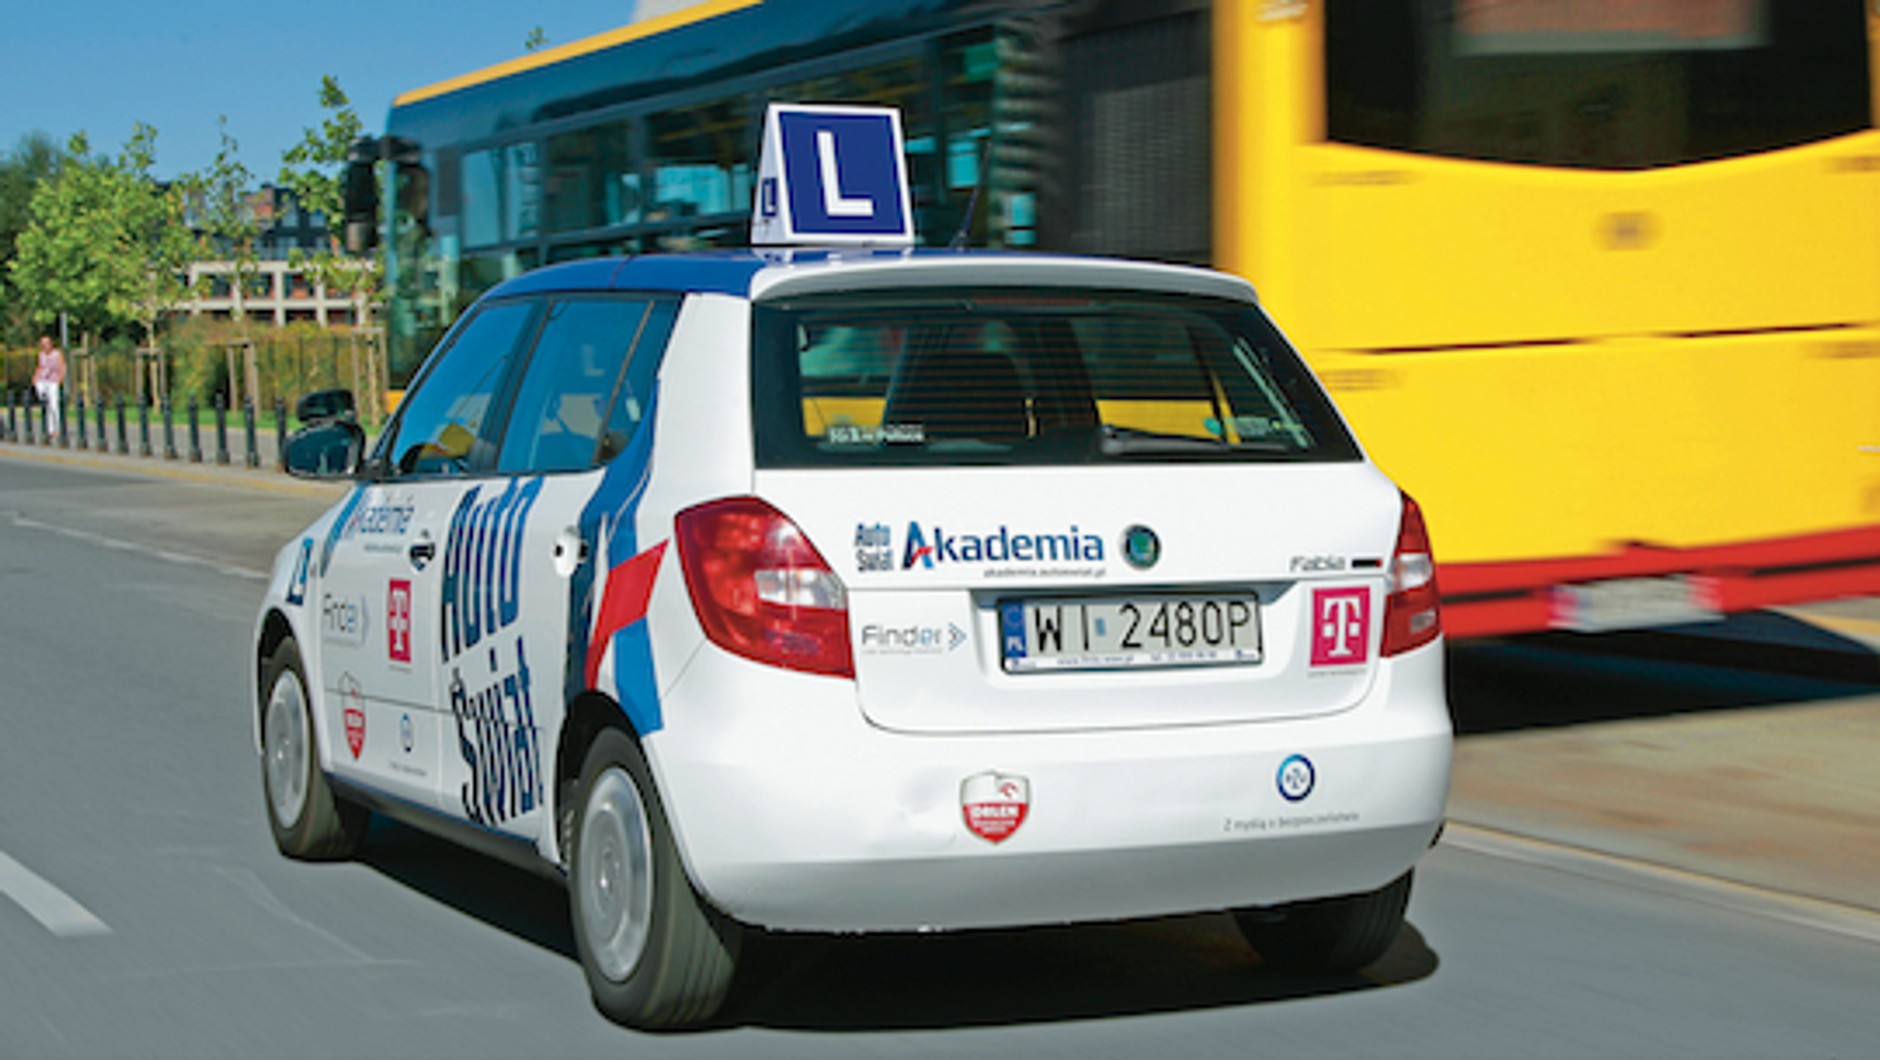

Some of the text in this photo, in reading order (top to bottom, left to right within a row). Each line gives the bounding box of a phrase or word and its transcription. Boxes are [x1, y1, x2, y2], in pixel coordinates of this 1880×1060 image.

[817, 131, 873, 216] L
[440, 476, 545, 665] Auto
[901, 520, 1105, 570] Akademia
[861, 625, 942, 647] Finder
[1119, 600, 1251, 649] 2480P
[1322, 595, 1362, 658] T
